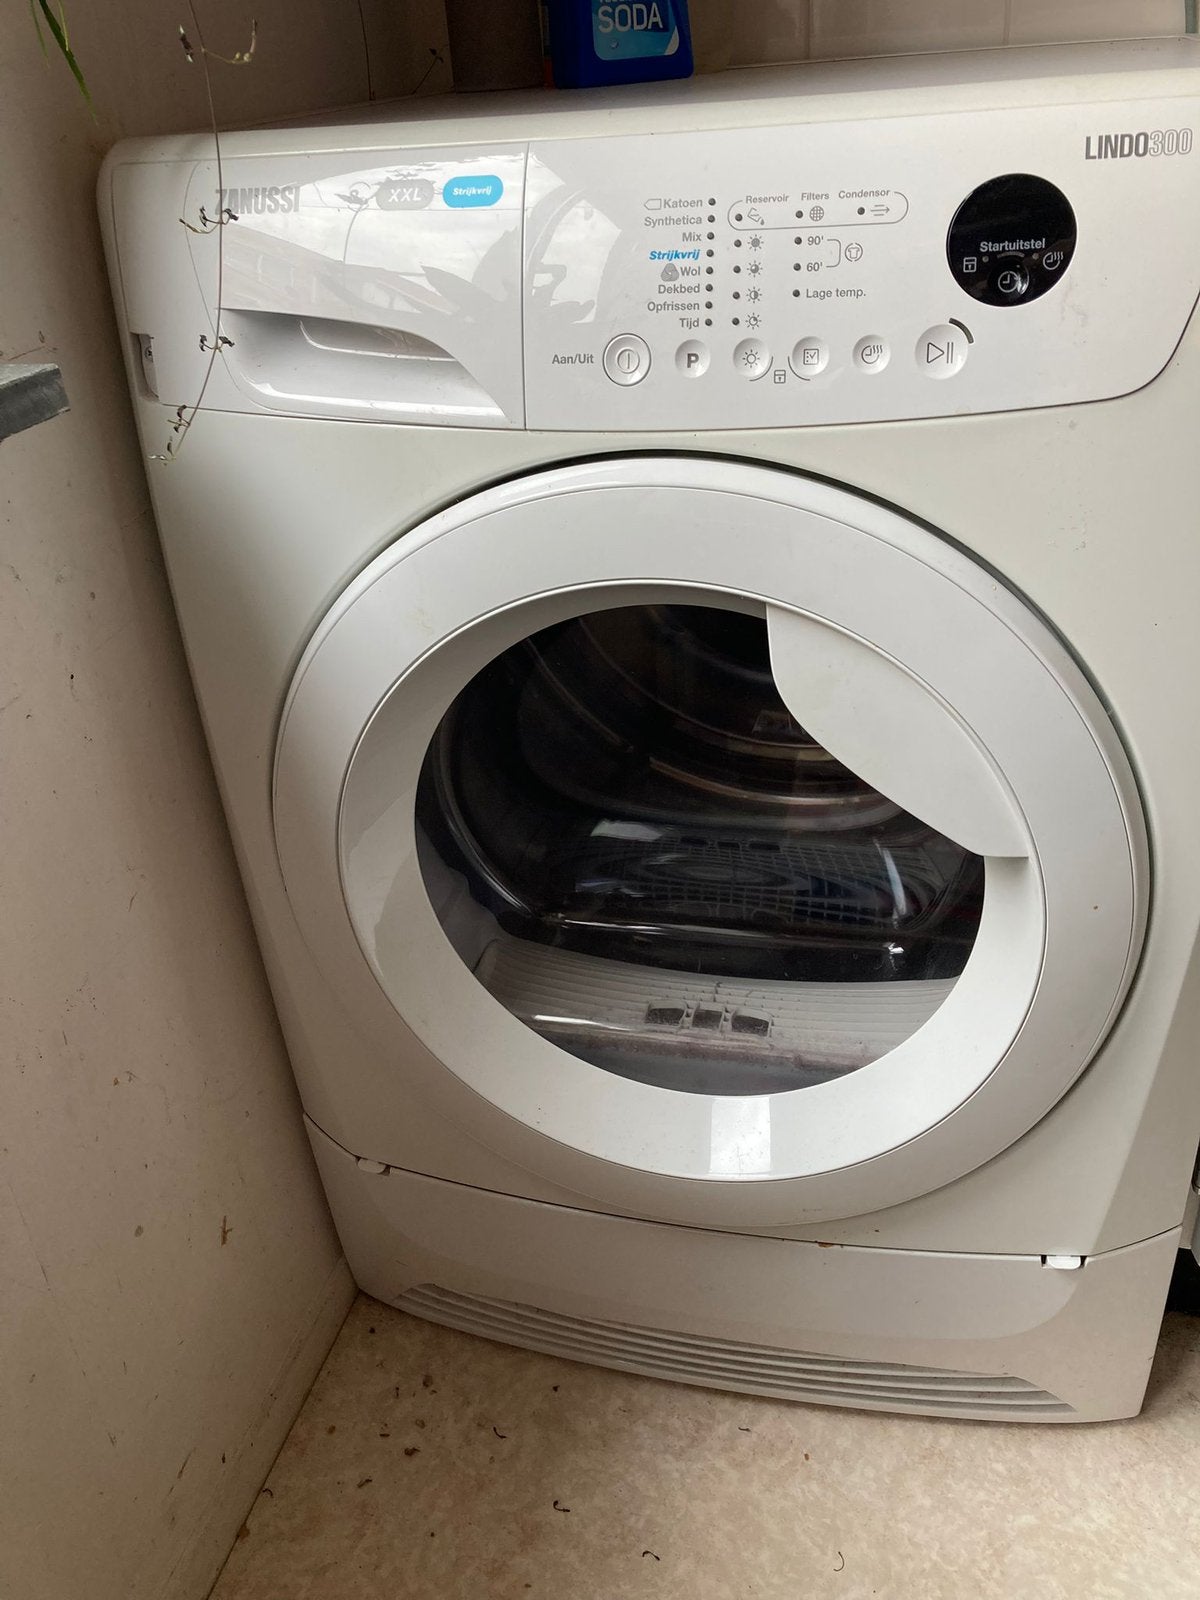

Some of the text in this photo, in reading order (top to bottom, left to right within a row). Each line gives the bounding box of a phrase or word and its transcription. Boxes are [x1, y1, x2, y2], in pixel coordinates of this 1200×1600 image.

[597, 2, 664, 33] SODA
[1085, 128, 1194, 160] LINDO300
[388, 187, 422, 202] XXL
[452, 185, 492, 197] Strijkvrij
[801, 191, 830, 202] Filters
[838, 188, 890, 199] Condensor
[215, 186, 300, 215] ZANUSSI
[663, 198, 703, 209] Katoen
[745, 194, 789, 204] Reservoir
[644, 215, 702, 227] Synthetica
[682, 231, 701, 242] Mix
[807, 235, 824, 246] 90'
[979, 237, 1046, 253] Startuitstel
[649, 249, 700, 261] Strijkvrij
[680, 266, 701, 277] Wol
[806, 261, 823, 272] 60'
[658, 283, 701, 295] Dekbed
[806, 288, 867, 299] Lage temp.
[647, 300, 700, 312] Opfrissen
[679, 317, 700, 329] Tijd
[552, 352, 595, 366] Aan/Uit
[686, 353, 700, 368] P
